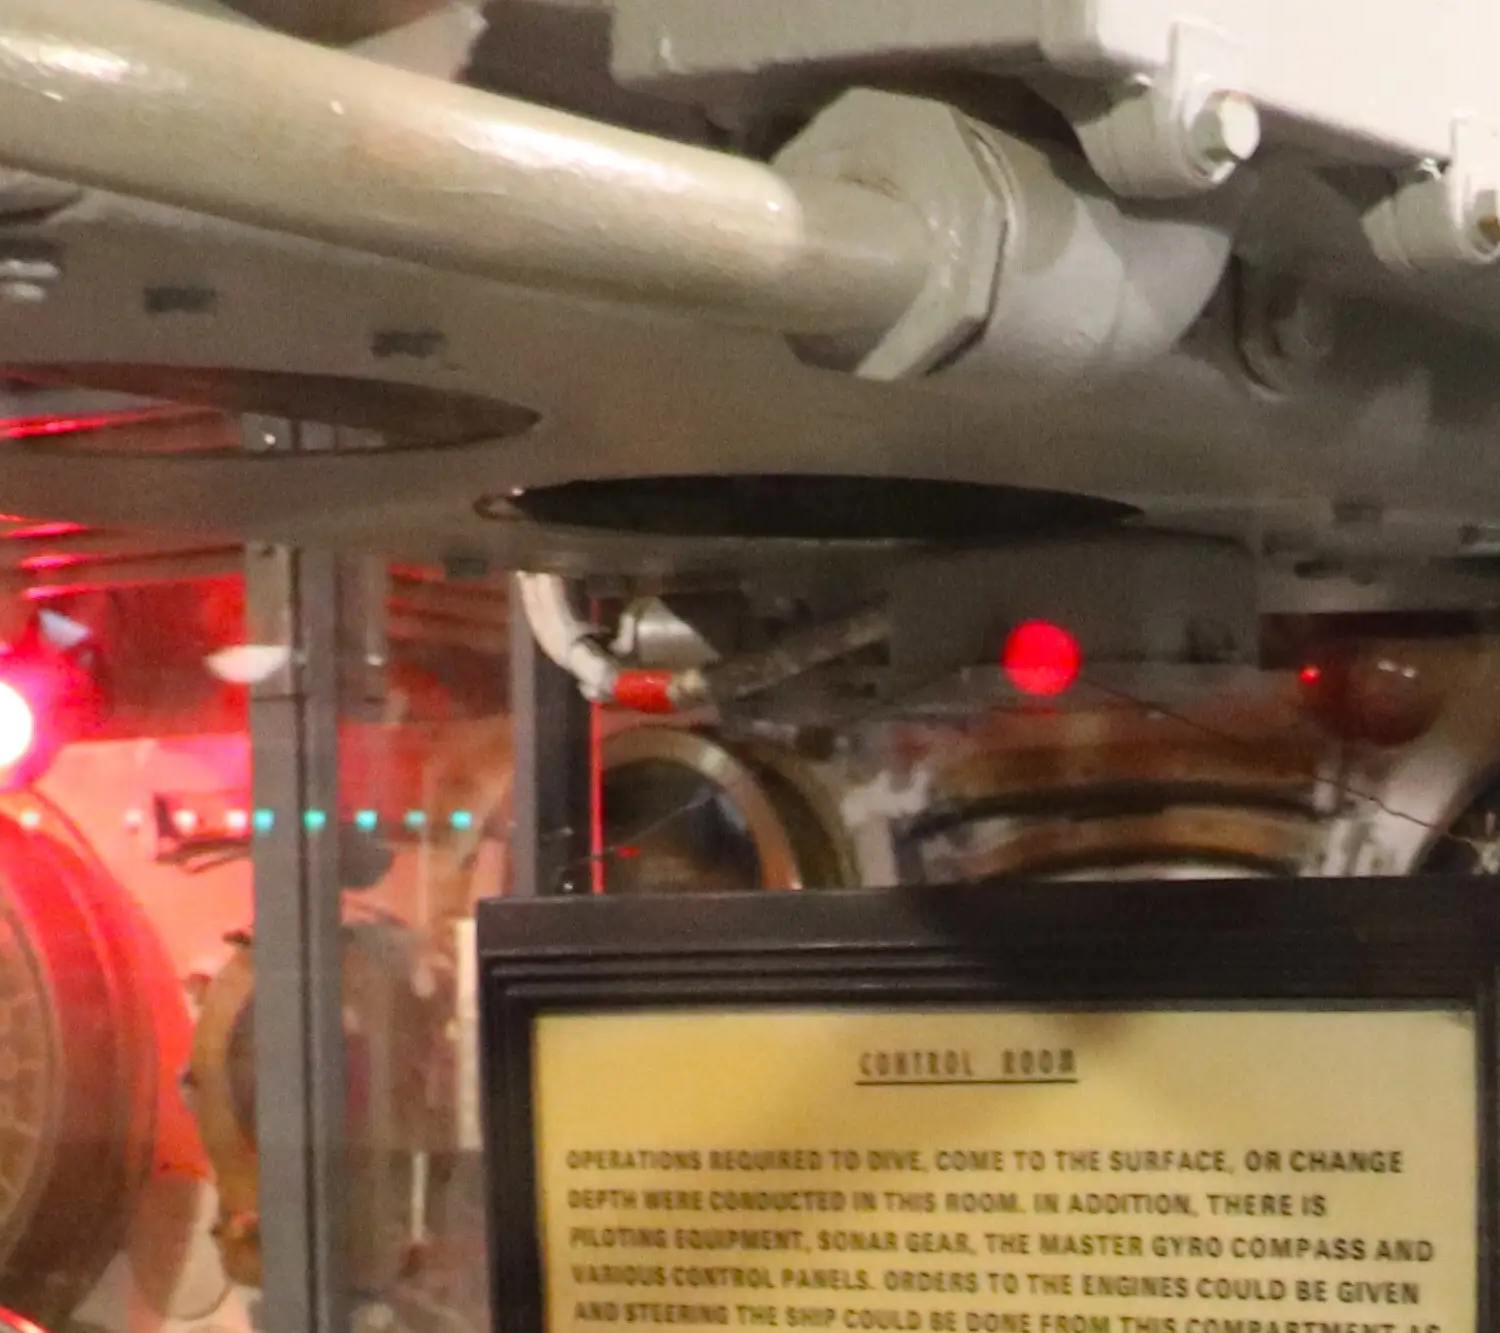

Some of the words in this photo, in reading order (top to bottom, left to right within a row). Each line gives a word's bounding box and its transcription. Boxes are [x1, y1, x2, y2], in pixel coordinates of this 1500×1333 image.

[857, 1049, 975, 1077] CONTROL
[1001, 1047, 1077, 1076] ROOM
[566, 1149, 702, 1172] OPERATIONS
[708, 1149, 823, 1172] REQUIRED
[831, 1149, 861, 1172] TO
[866, 1149, 928, 1174] DIVE,
[935, 1149, 1005, 1173] COME
[1014, 1150, 1046, 1173] TO
[1055, 1150, 1101, 1173] THE
[1108, 1149, 1235, 1175] SURFACE,
[1243, 1149, 1282, 1173] OR
[1289, 1149, 1404, 1174] CHANGE
[566, 1189, 638, 1212] DEPTH
[641, 1190, 703, 1212] WERE
[709, 1190, 847, 1213] CONDUCTED
[852, 1190, 878, 1213] IN
[883, 1191, 937, 1214] THIS
[945, 1191, 1027, 1215] ROOM.
[1033, 1193, 1060, 1215] IN
[1205, 1193, 1293, 1217] THERE
[1300, 1194, 1328, 1218] IS
[569, 1226, 668, 1250] PILOTING
[673, 1227, 813, 1255] EQUIPMENT,
[817, 1230, 899, 1253] SONAR
[985, 1232, 1031, 1255] THE
[1039, 1233, 1145, 1258] MASTER
[1150, 1235, 1224, 1259] GYRO
[1230, 1236, 1368, 1262] COMPASS
[1373, 1239, 1436, 1263] AND
[570, 1265, 668, 1288] VARIOUS
[671, 1267, 776, 1290] CONTROL
[781, 1268, 877, 1292] PANELS.
[882, 1270, 979, 1294] ORDERS
[986, 1272, 1019, 1295] TO
[1026, 1273, 1074, 1297] THE
[1081, 1274, 1190, 1299] ENGINES
[1195, 1276, 1287, 1302] COULD
[1294, 1279, 1328, 1303] BE
[1335, 1280, 1421, 1305] GIVEN
[573, 1301, 620, 1323] AND
[623, 1302, 730, 1326] STEERING
[734, 1304, 779, 1327] THE
[785, 1306, 837, 1328] SHIP
[842, 1308, 923, 1332] COULD
[929, 1310, 958, 1333] BE
